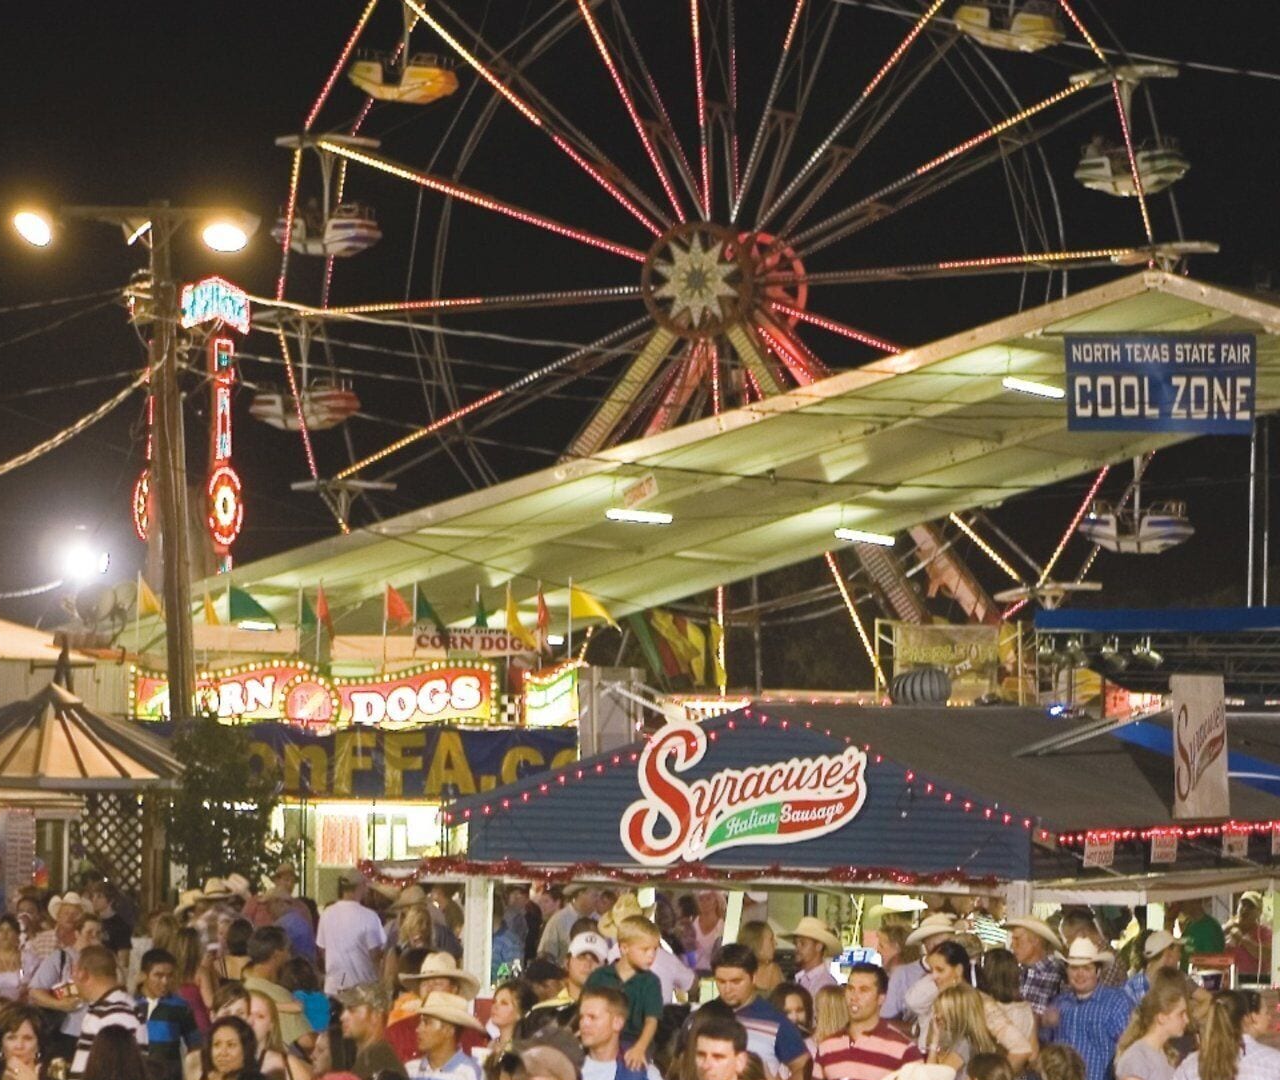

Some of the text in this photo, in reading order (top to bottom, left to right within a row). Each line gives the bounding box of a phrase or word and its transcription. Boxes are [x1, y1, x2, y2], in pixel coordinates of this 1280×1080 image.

[1071, 343, 1251, 365] NORTH TEXAS STATE FAIR
[1074, 376, 1251, 421] COOL ZONE
[416, 634, 536, 652] CORN DOG
[349, 674, 482, 726] DOGS
[625, 727, 863, 860] Syracuse's
[725, 802, 845, 839] Italian Sausage
